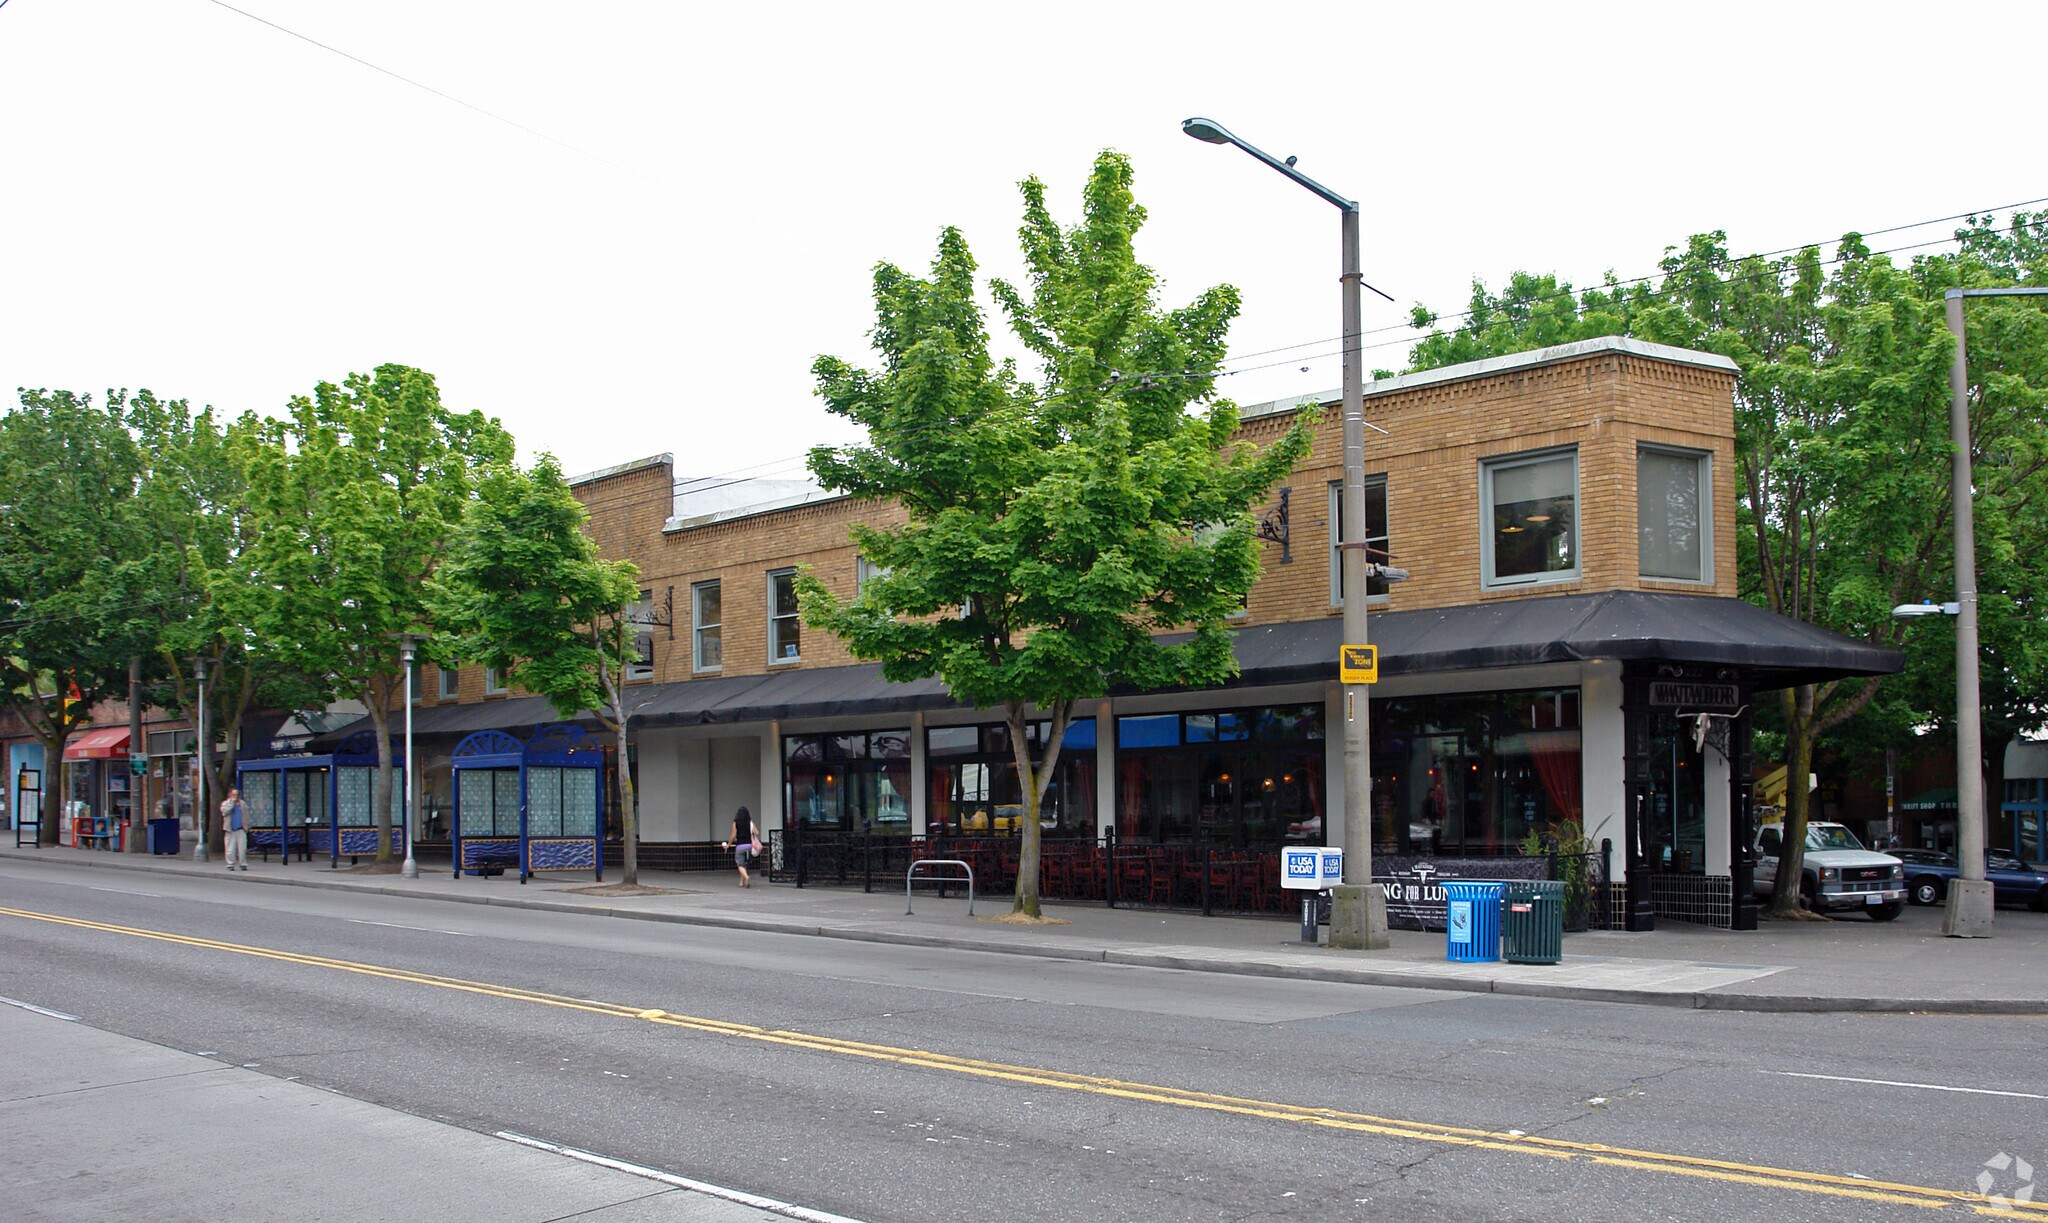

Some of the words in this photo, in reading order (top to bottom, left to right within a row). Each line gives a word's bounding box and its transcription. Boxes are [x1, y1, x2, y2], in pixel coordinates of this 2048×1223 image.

[1920, 802, 1936, 810] SHOP
[1940, 801, 1957, 809] THR
[1297, 856, 1313, 866] USA
[1290, 865, 1314, 874] TODAY
[1324, 866, 1339, 874] TODAY
[1405, 885, 1419, 901] FOR
[1424, 886, 1448, 901] LUN
